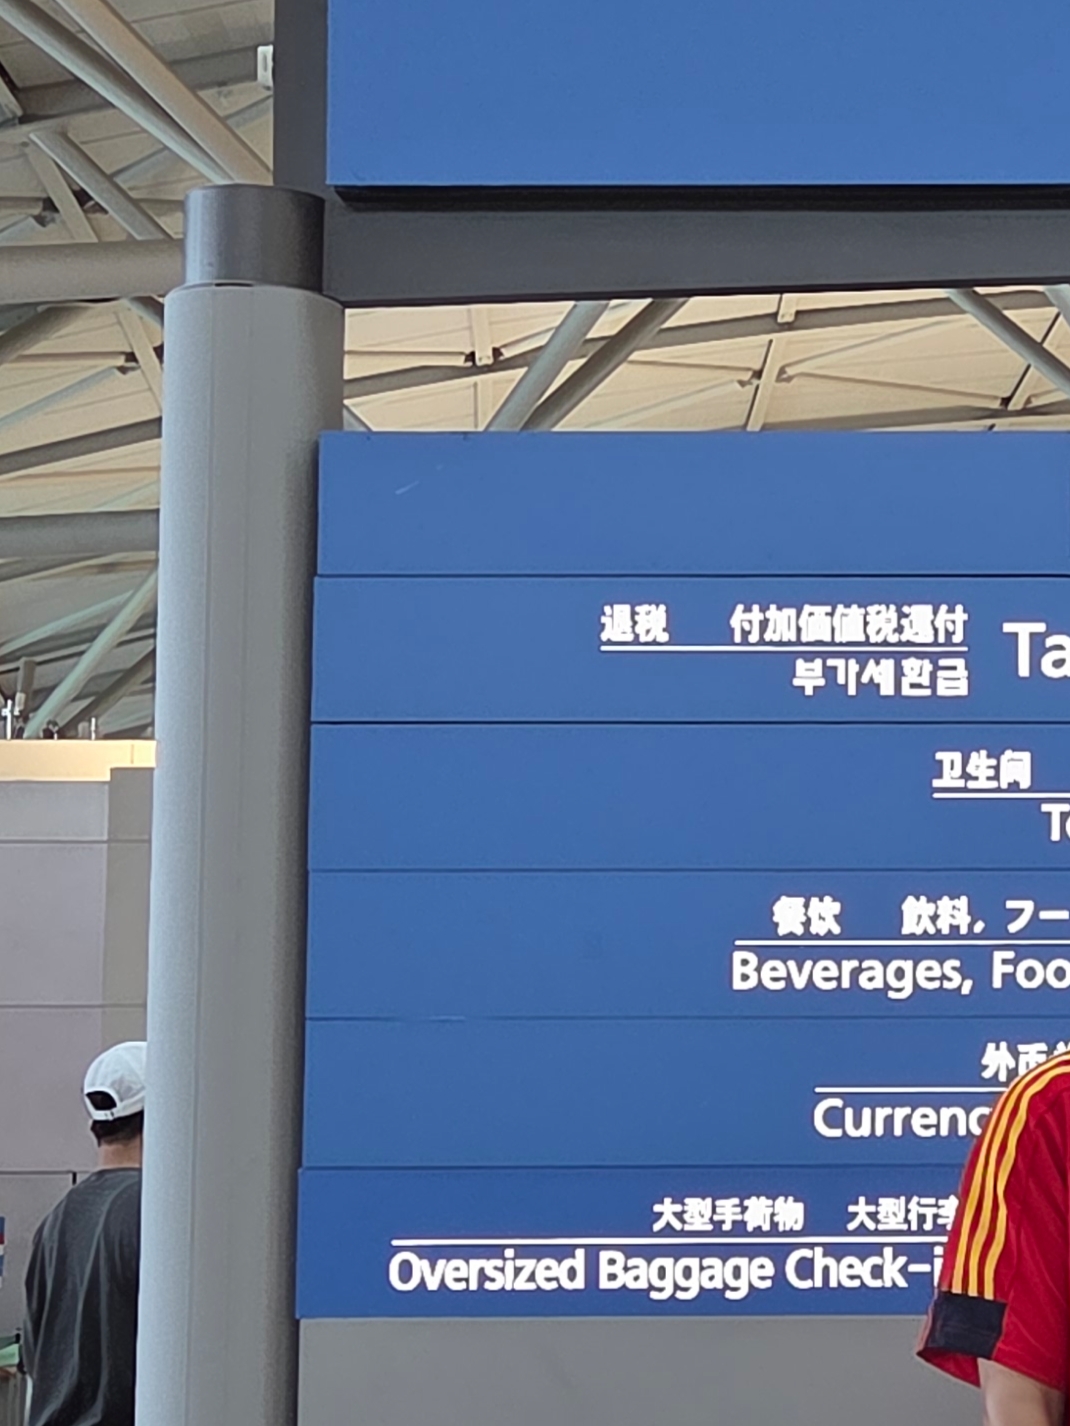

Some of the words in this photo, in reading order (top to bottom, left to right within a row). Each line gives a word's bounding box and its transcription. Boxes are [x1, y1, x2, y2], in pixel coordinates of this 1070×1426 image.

[600, 603, 670, 643] 退税
[792, 656, 970, 698] 부가세환급
[931, 749, 1033, 790] 卫生间
[772, 895, 842, 937] 餐饮
[732, 950, 974, 1000] Beverages,
[652, 1196, 805, 1232] 大型手荷物
[388, 1248, 586, 1292] Oversized
[598, 1250, 776, 1301] Baggage
